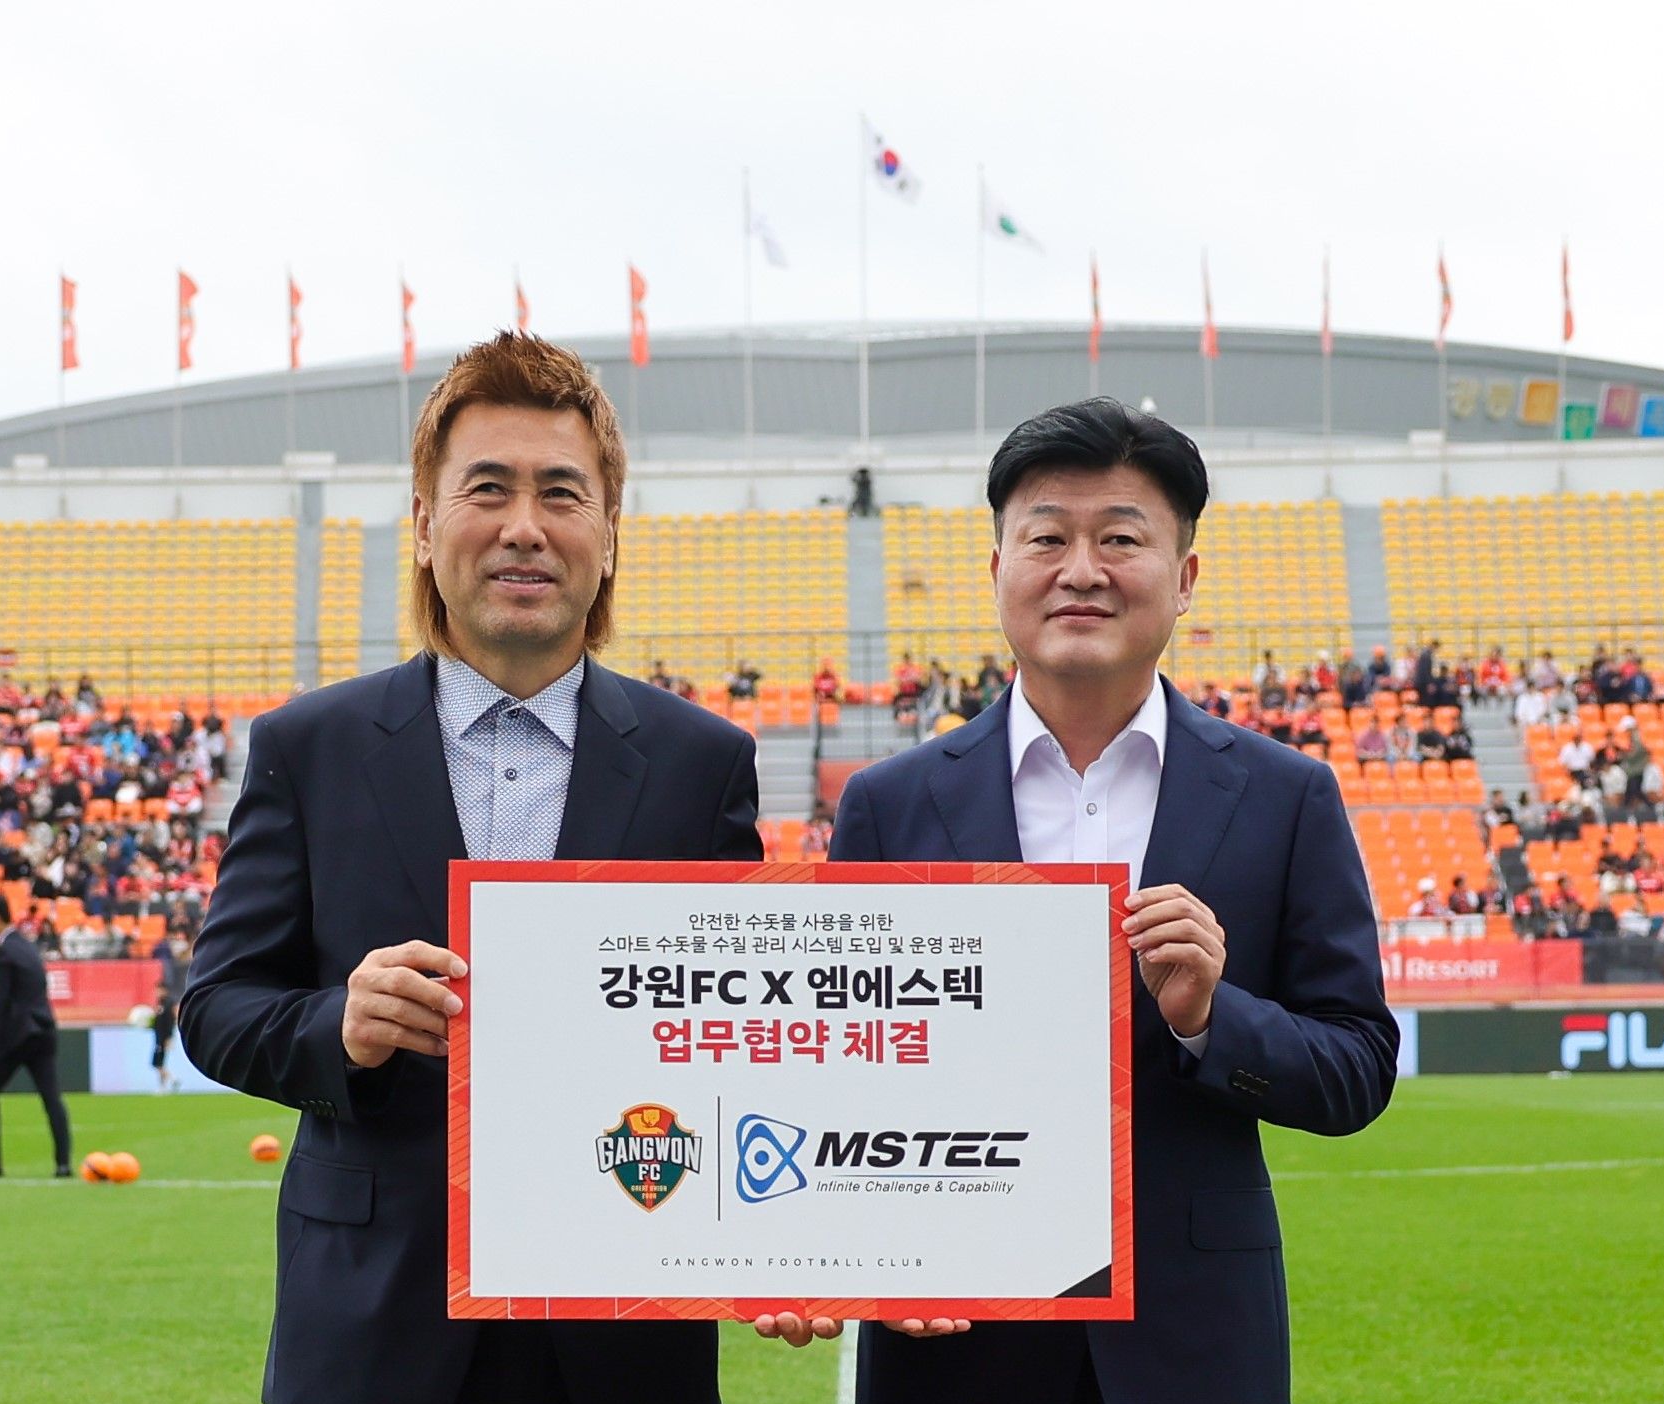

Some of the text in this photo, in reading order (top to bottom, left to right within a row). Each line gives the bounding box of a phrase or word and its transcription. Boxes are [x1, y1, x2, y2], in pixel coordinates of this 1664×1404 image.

[688, 912, 894, 932] 안전한 수돗물 사용을 위한
[598, 934, 983, 955] 스마트 수돗물 수질 관리 시스템 도입 및 운영 관련
[598, 963, 983, 1010] 강원FC X 엠에스텍
[652, 1018, 930, 1065] 업무협약 체결
[596, 1136, 702, 1174] GANGWON
[814, 1131, 1029, 1168] MSTEC
[637, 1162, 662, 1182] FC
[816, 1180, 1015, 1195] Infinite Challenge & Capability
[661, 1257, 922, 1267] GANGWON FOOTBALL CLUB
